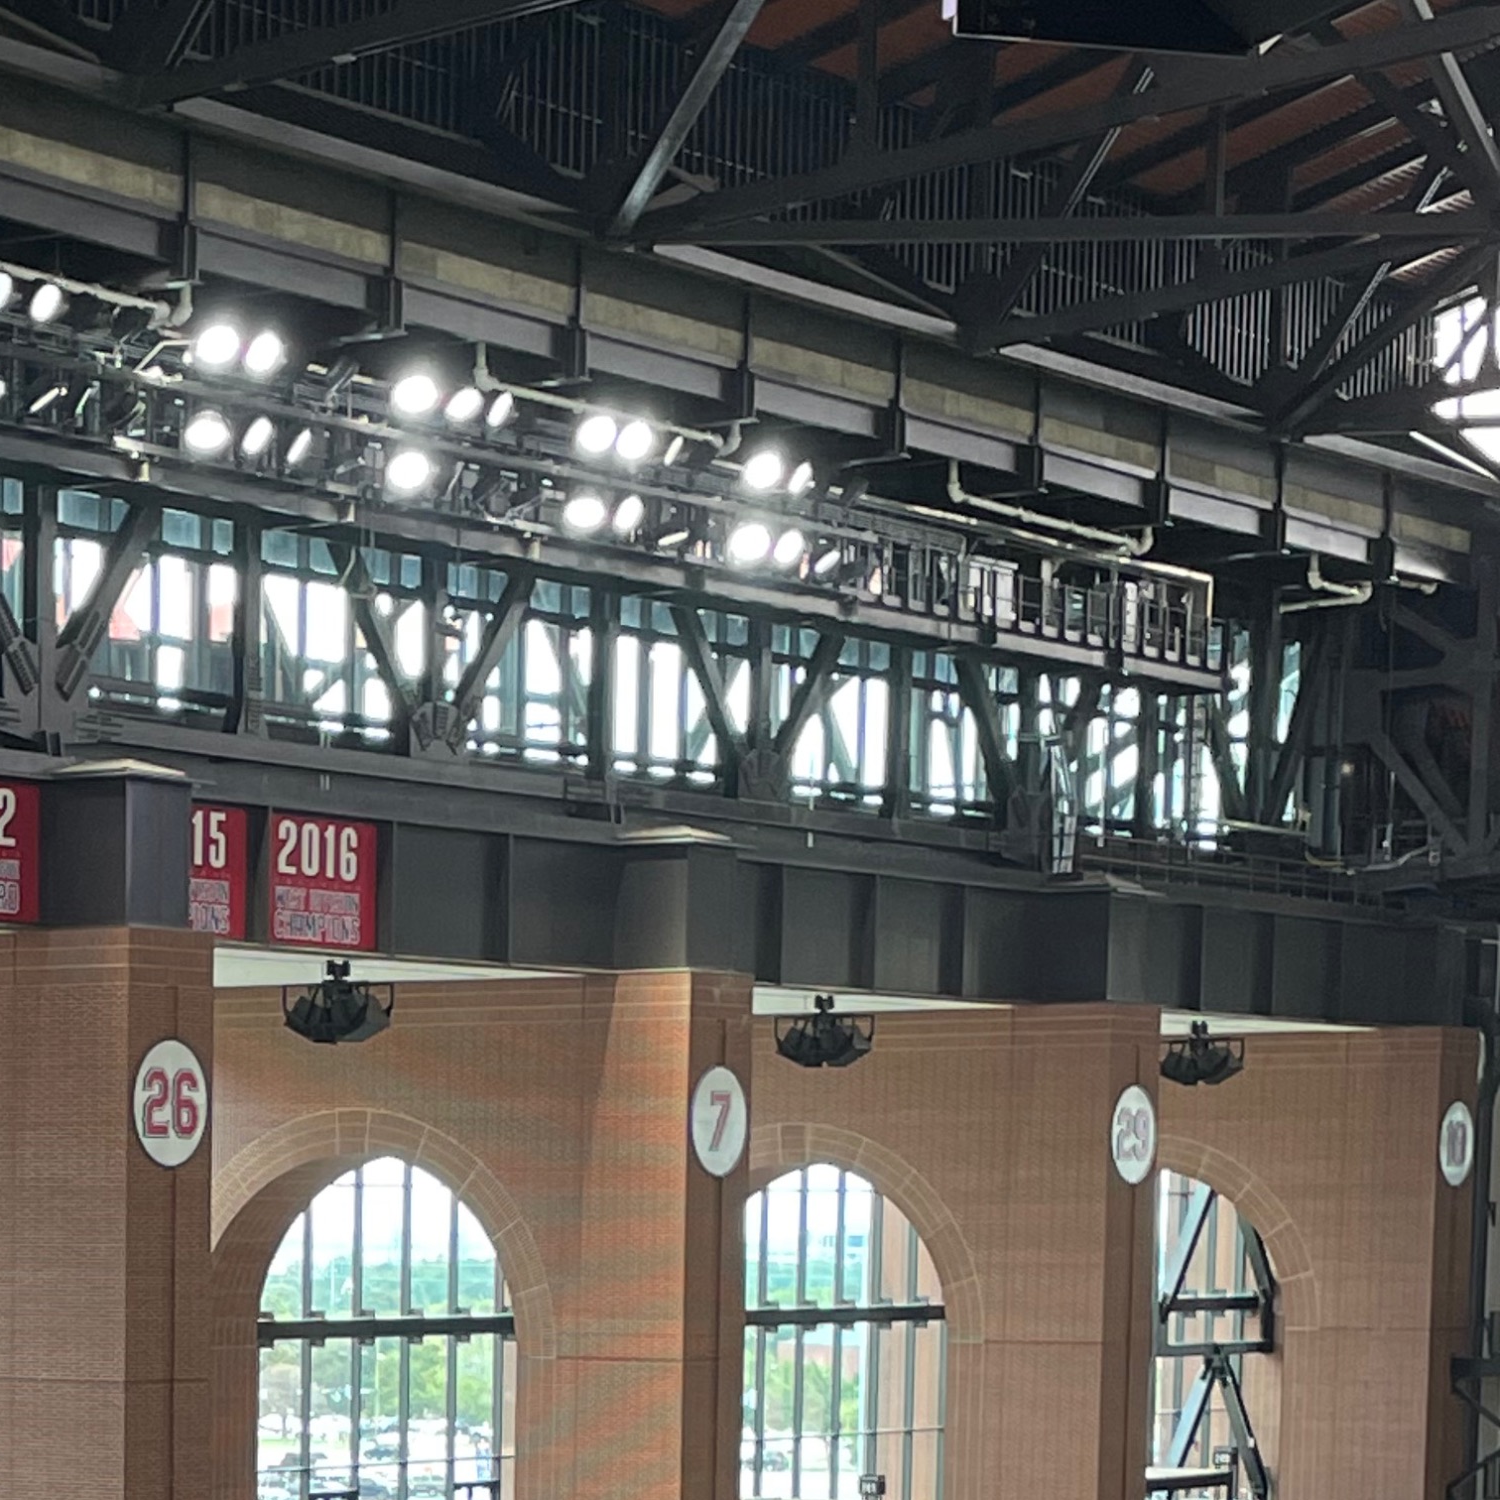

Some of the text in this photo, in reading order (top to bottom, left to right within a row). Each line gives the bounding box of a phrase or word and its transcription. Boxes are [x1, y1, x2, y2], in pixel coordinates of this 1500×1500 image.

[192, 809, 227, 869] 15
[277, 819, 359, 882] 2016
[142, 1066, 200, 1140] 26
[708, 1090, 732, 1152] 7
[1116, 1106, 1150, 1161] 29
